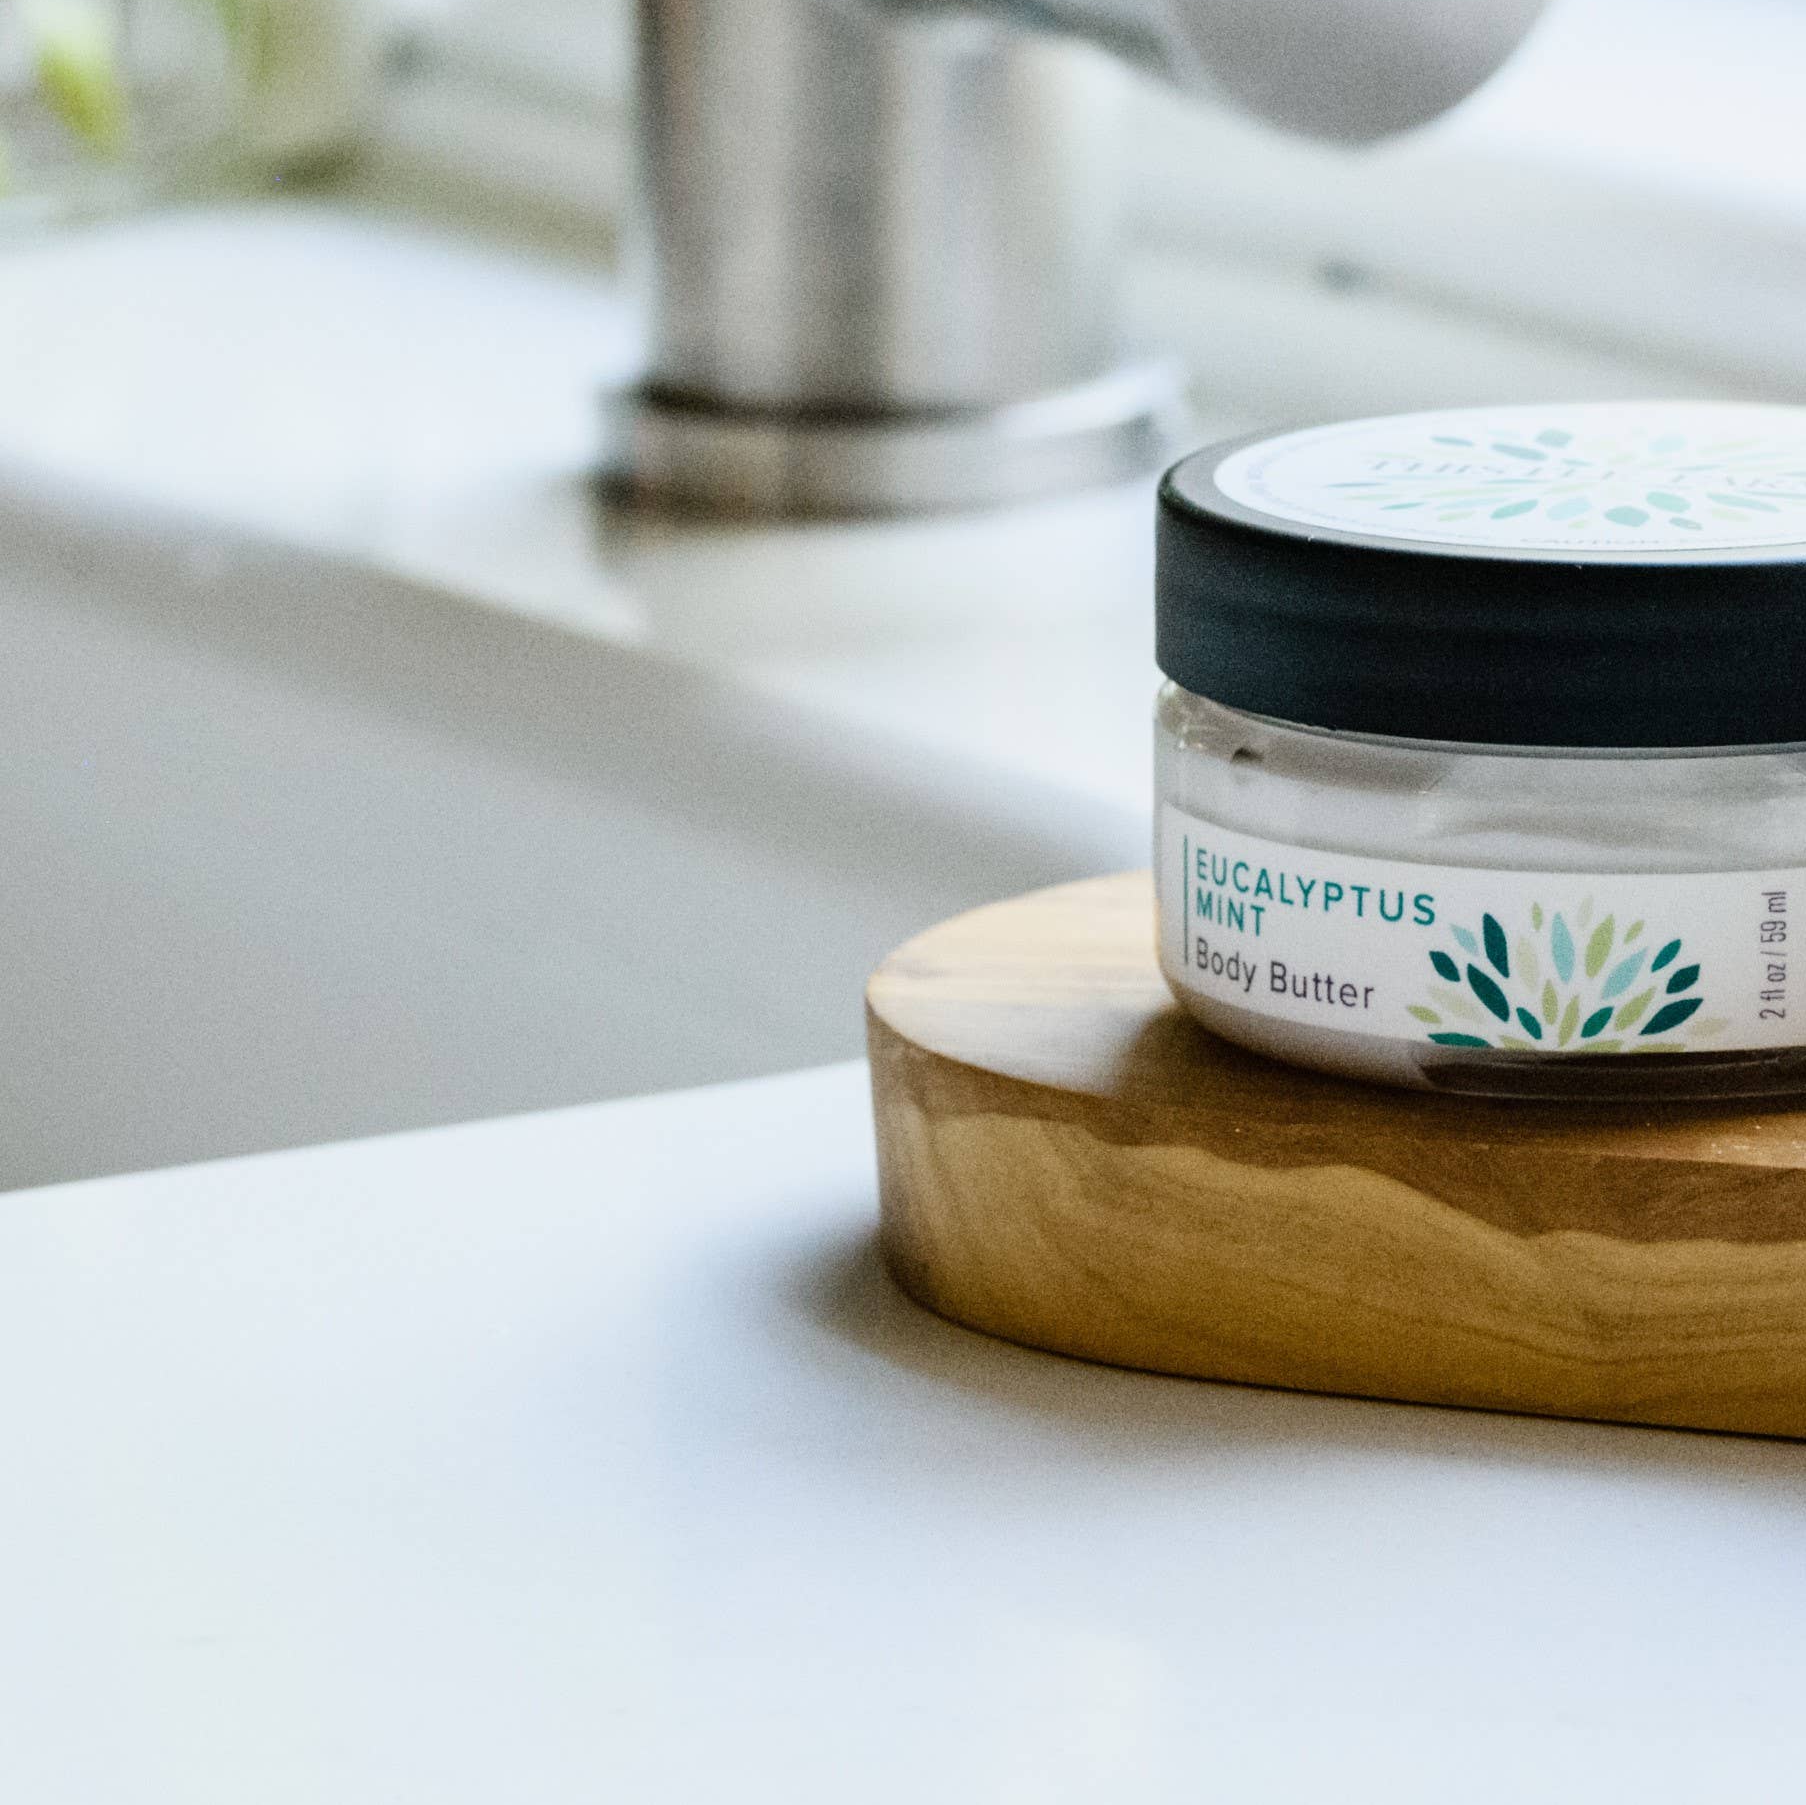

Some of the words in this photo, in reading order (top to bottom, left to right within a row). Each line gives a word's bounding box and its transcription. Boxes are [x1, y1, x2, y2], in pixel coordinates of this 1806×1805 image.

[1197, 848, 1436, 926] EUCALYPTUS
[1197, 886, 1267, 938] MINT
[1761, 891, 1787, 914] ml
[1760, 920, 1787, 943] 59
[1197, 938, 1256, 993] Body
[1269, 960, 1375, 1010] Butter
[1767, 963, 1786, 983] oz
[1760, 988, 1786, 1002] fl
[1759, 1008, 1786, 1020] 2
